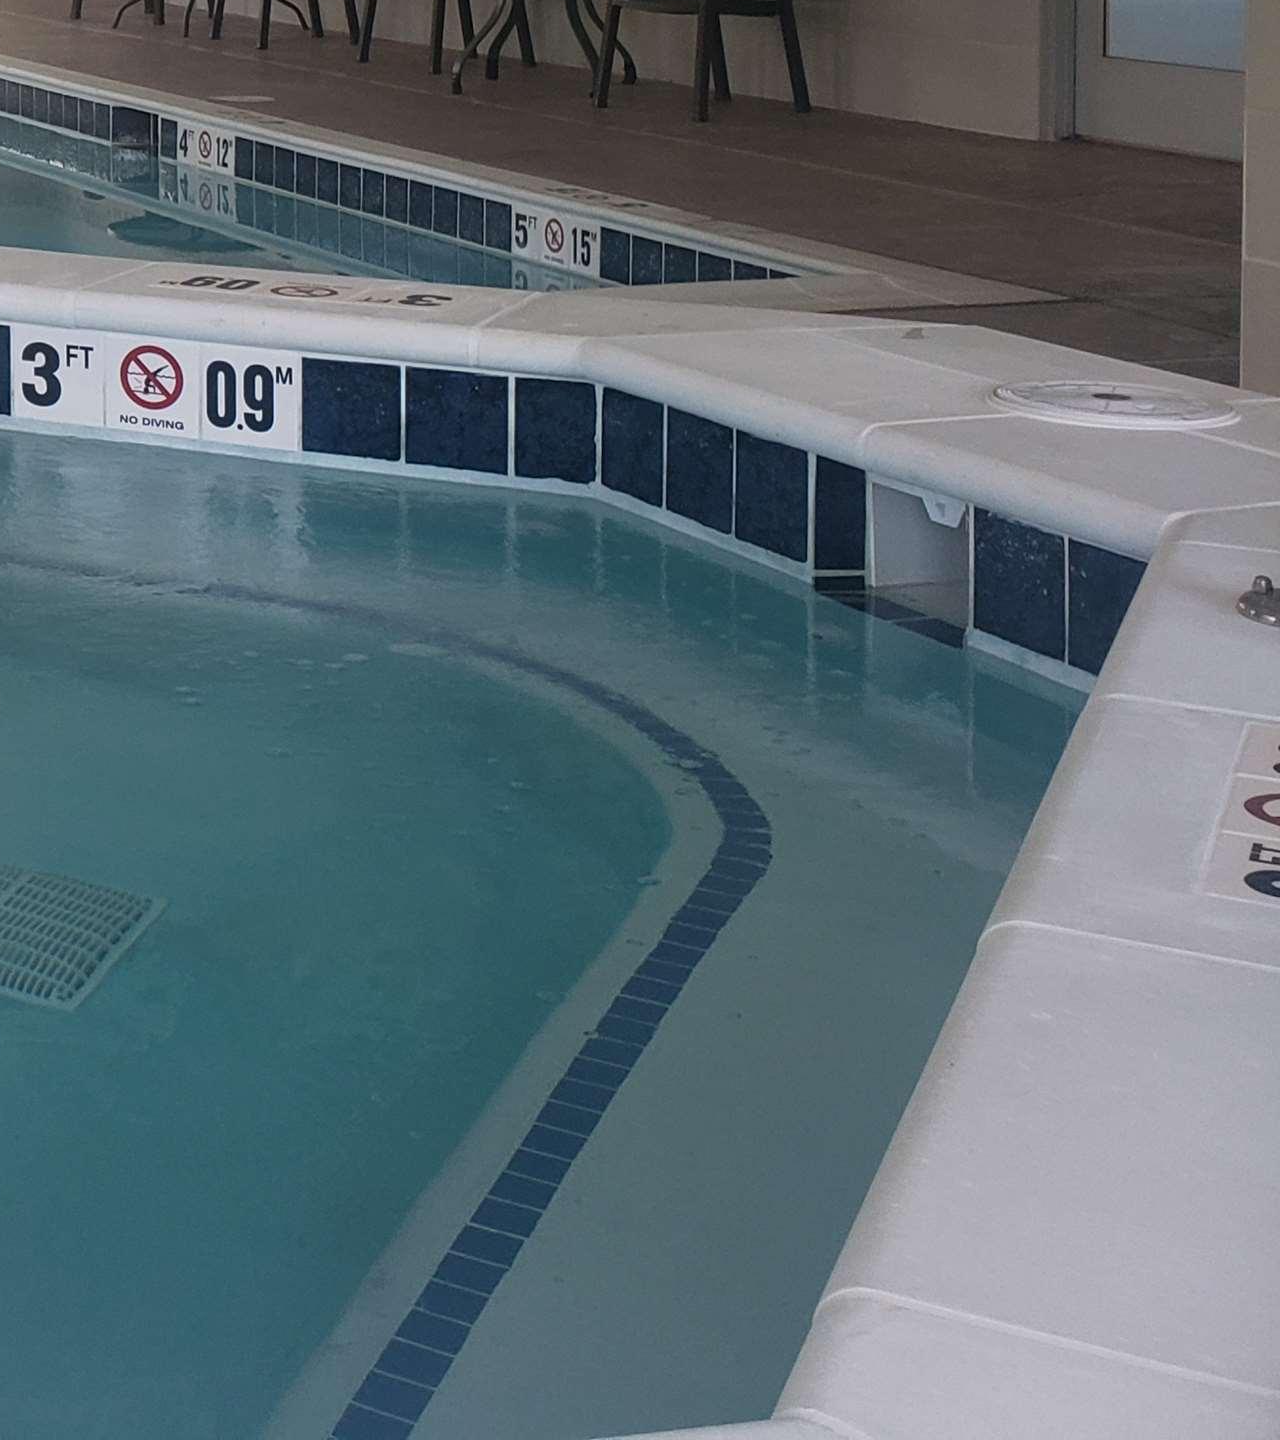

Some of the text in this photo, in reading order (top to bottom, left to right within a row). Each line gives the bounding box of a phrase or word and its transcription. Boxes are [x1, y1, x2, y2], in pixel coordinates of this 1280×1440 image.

[21, 341, 62, 407] 3
[120, 414, 184, 430] NO DIVING
